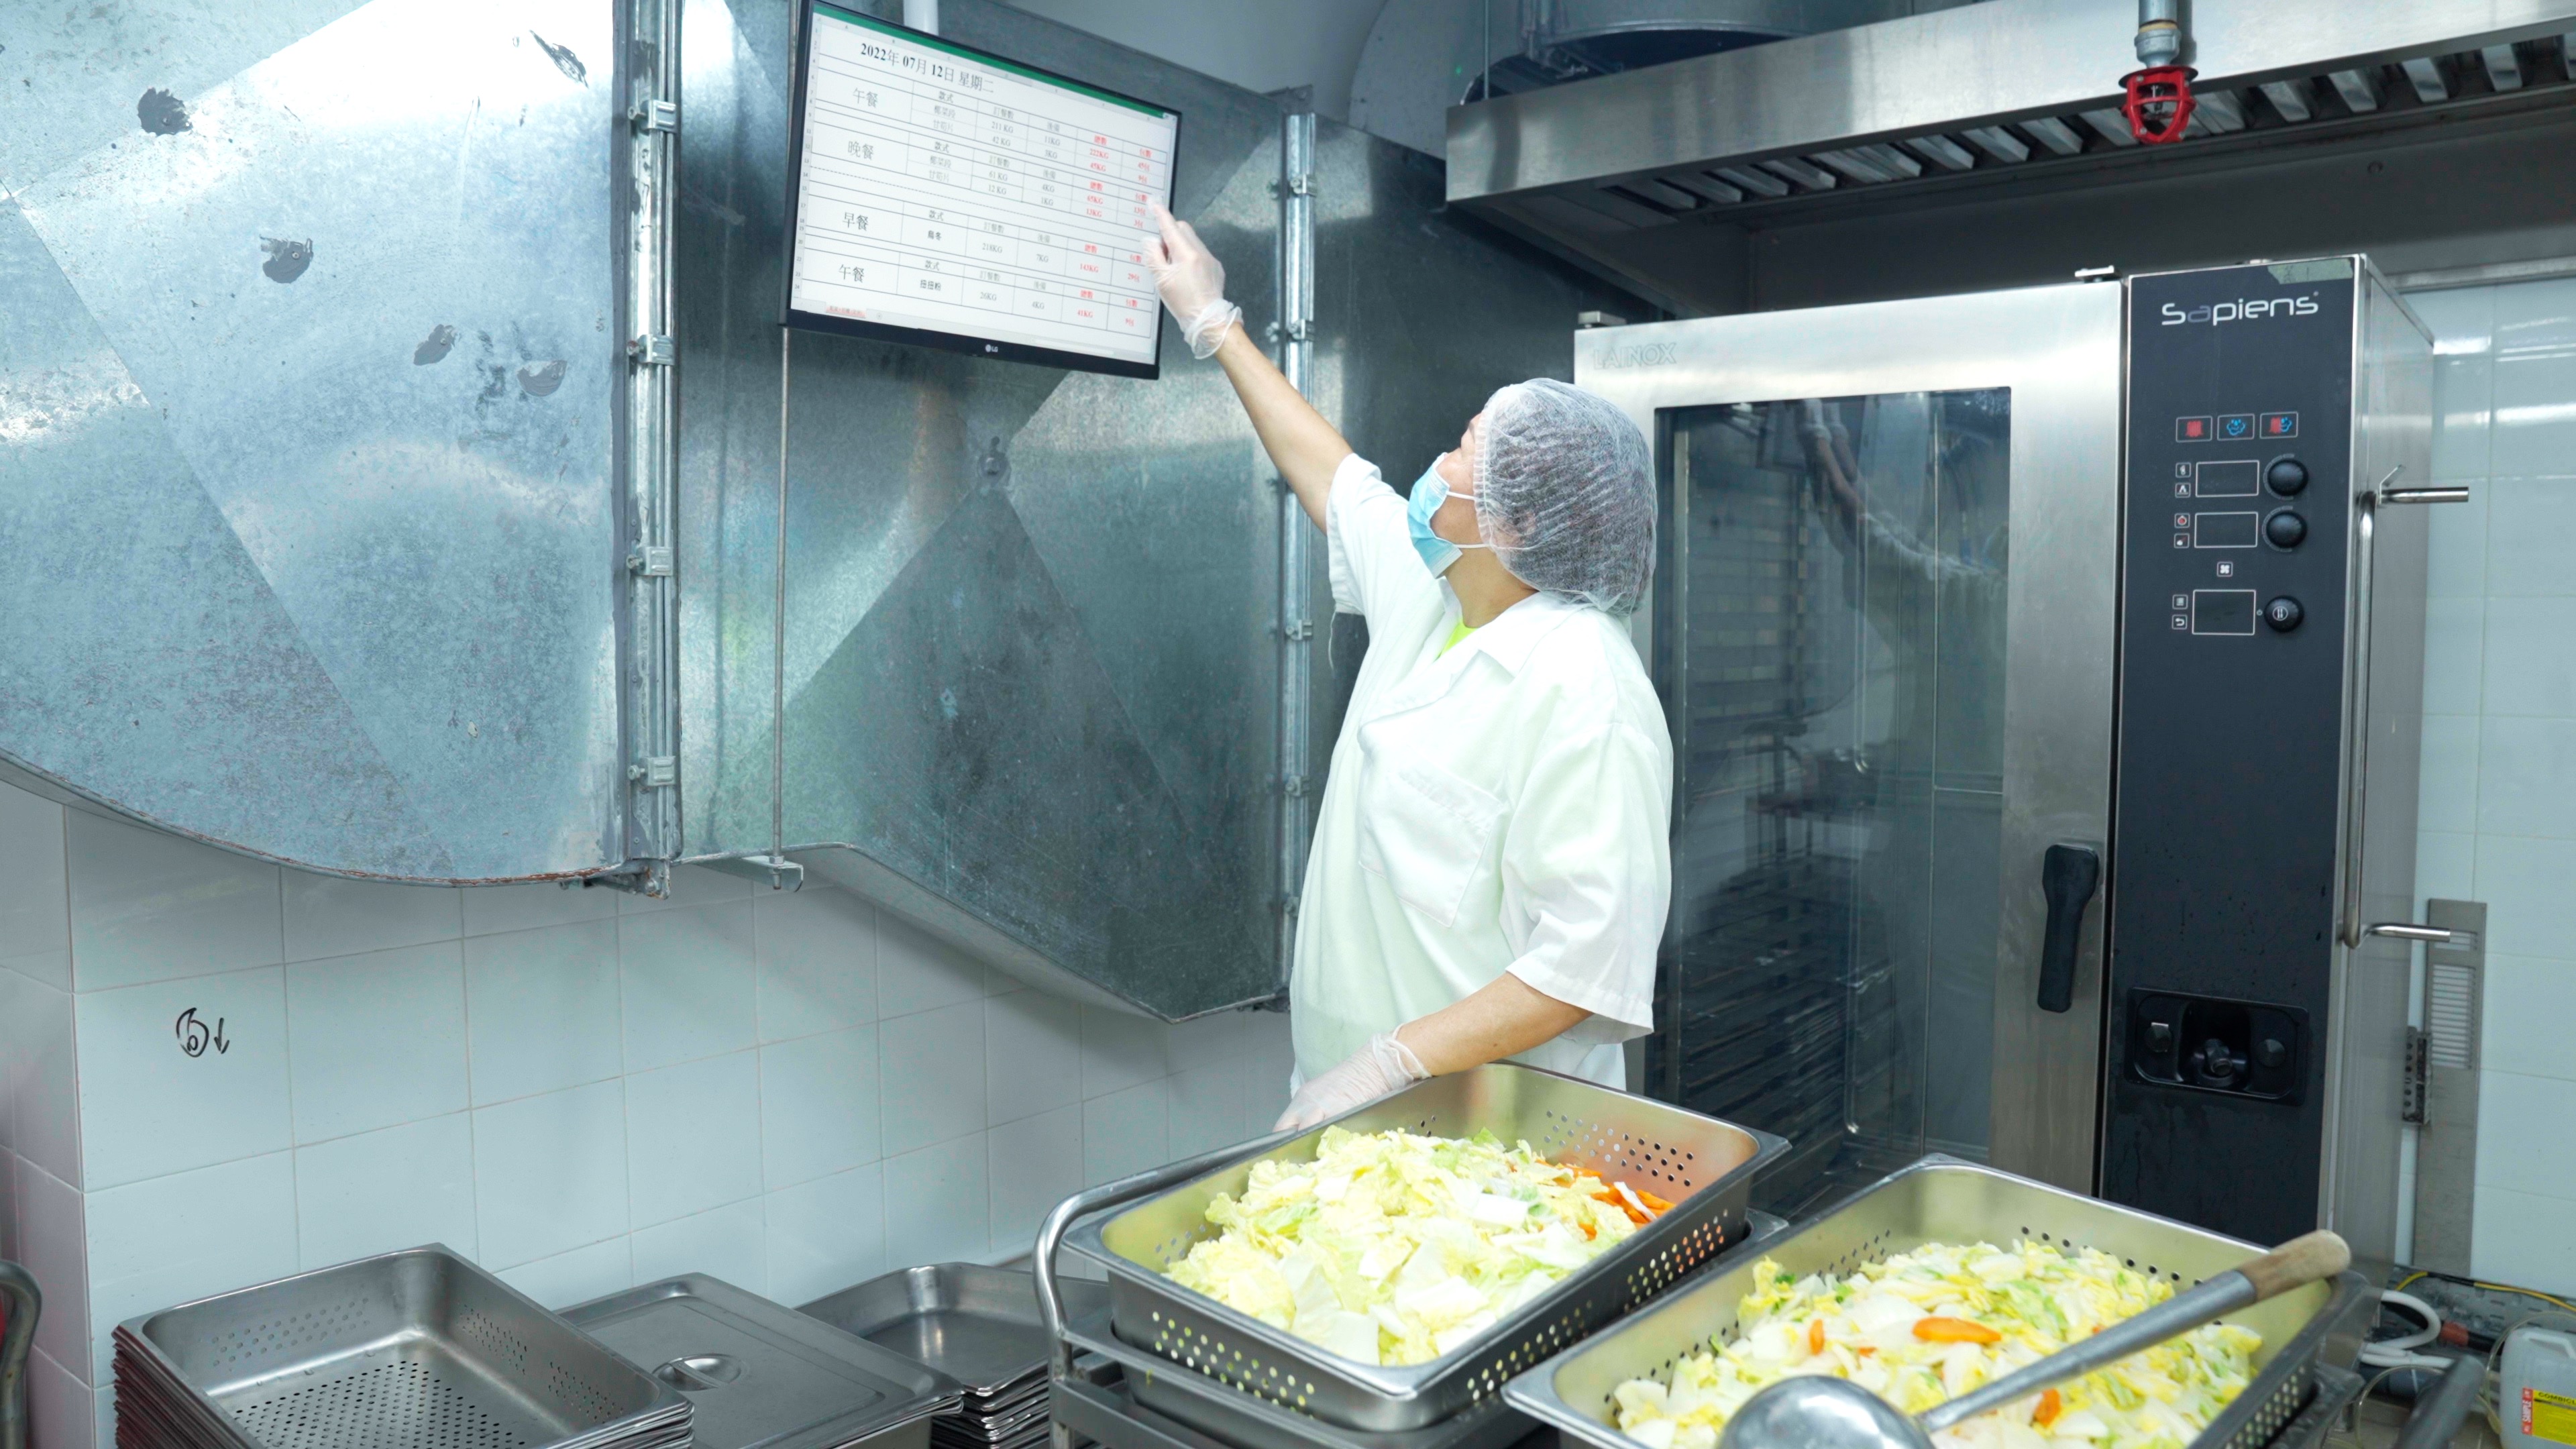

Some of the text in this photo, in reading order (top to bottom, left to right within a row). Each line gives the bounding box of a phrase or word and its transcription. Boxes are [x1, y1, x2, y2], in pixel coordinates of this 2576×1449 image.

[861, 42, 994, 93] 2022年 07月 12日 星期二
[853, 87, 879, 107] 午餐
[991, 121, 1014, 133] 211 KG
[992, 136, 1011, 147] 42 KG
[1044, 135, 1061, 146] 11KG
[848, 140, 875, 160] 晚餐
[1044, 148, 1058, 159] 3KG
[1089, 147, 1110, 160] 222KG
[998, 172, 1009, 182] KG
[988, 183, 1007, 195] 12 KG
[1042, 182, 1055, 193] 4KG
[1041, 195, 1054, 206] 1KG
[843, 211, 869, 231] 早餐
[982, 242, 1003, 253] 218KG
[1036, 253, 1049, 262] 7KG
[839, 264, 865, 282] 午餐
[980, 291, 997, 301] 26KG
[1032, 299, 1045, 309] 4KG
[2161, 297, 2318, 326] Sapiens
